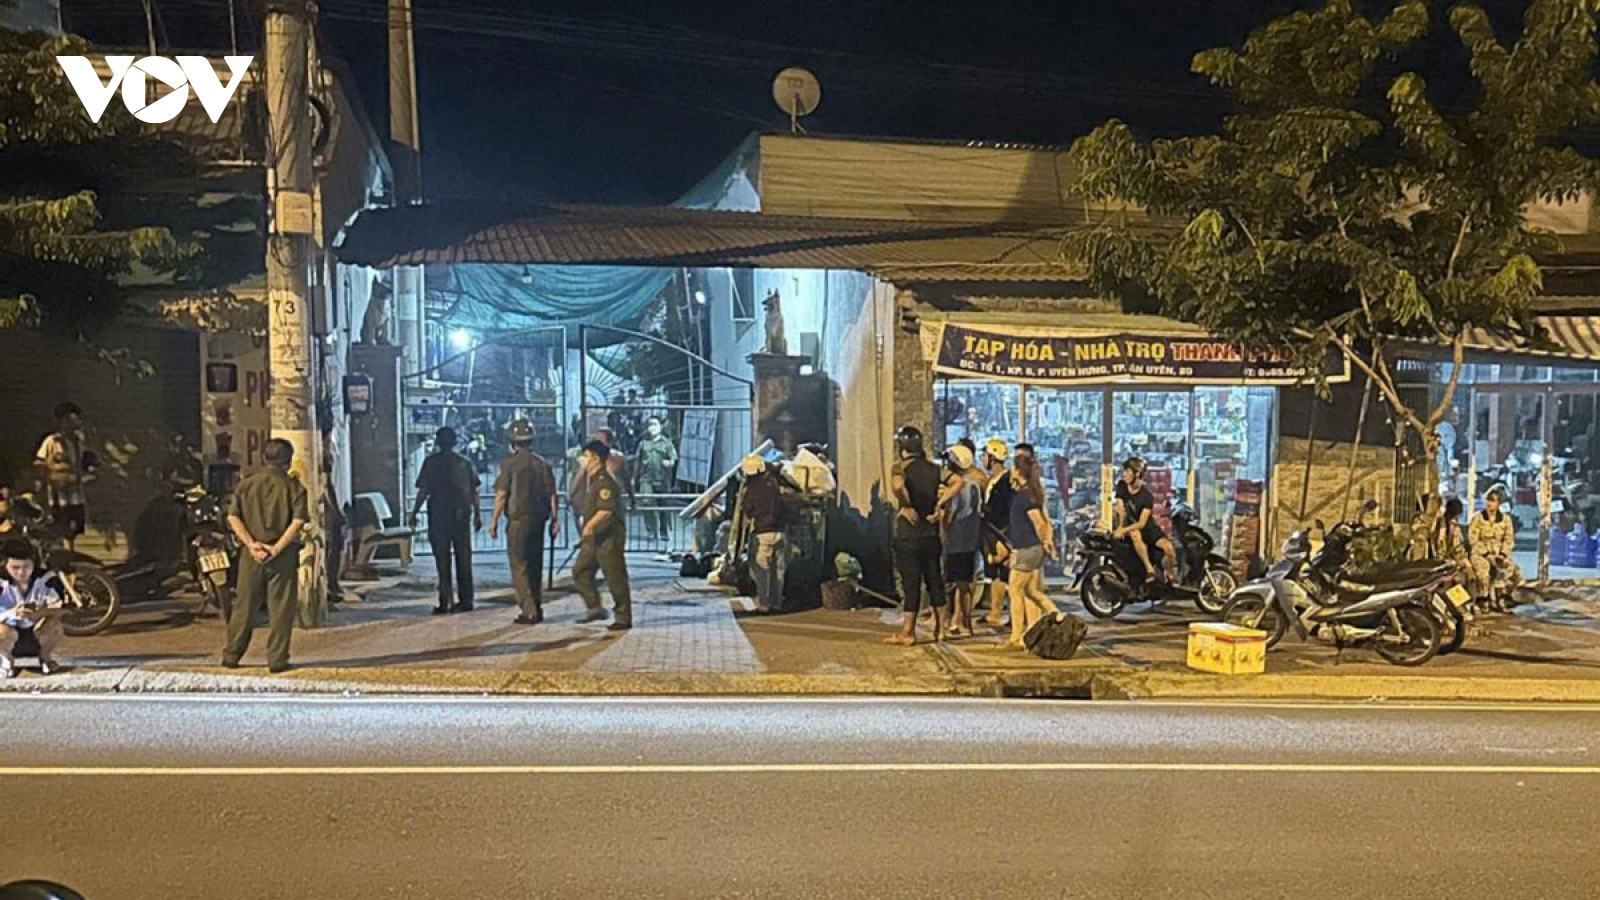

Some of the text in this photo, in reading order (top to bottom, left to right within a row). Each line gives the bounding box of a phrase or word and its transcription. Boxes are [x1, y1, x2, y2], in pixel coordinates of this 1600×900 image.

[963, 335, 1005, 358] TẠP
[1011, 340, 1055, 360] HÓA
[1075, 339, 1121, 360] NHÀ
[1125, 340, 1165, 362] TRỌ
